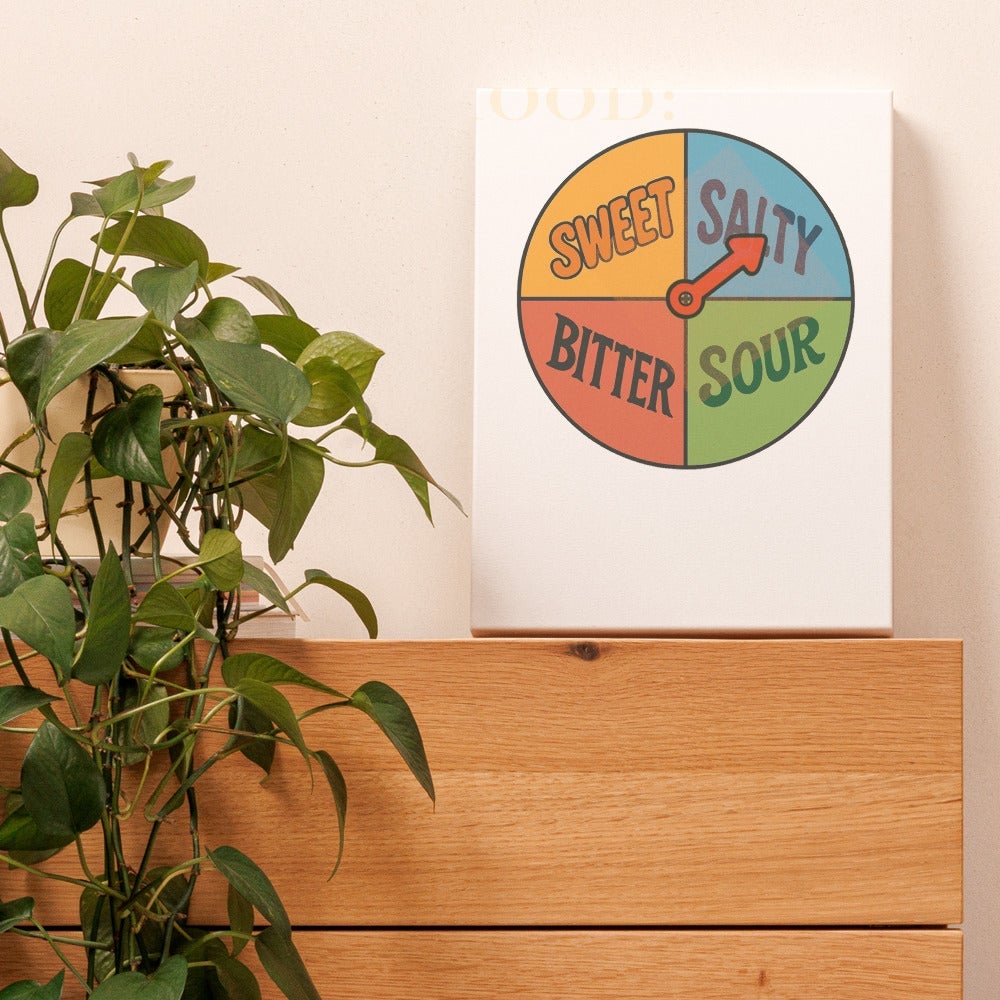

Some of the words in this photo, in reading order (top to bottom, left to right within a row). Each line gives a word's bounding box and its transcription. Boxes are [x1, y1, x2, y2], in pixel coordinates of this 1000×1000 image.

[476, 87, 674, 121] OOD:
[549, 176, 675, 279] SWEET
[697, 178, 823, 275] SALTY
[546, 312, 676, 418] BITTER
[698, 316, 826, 408] SOUR
